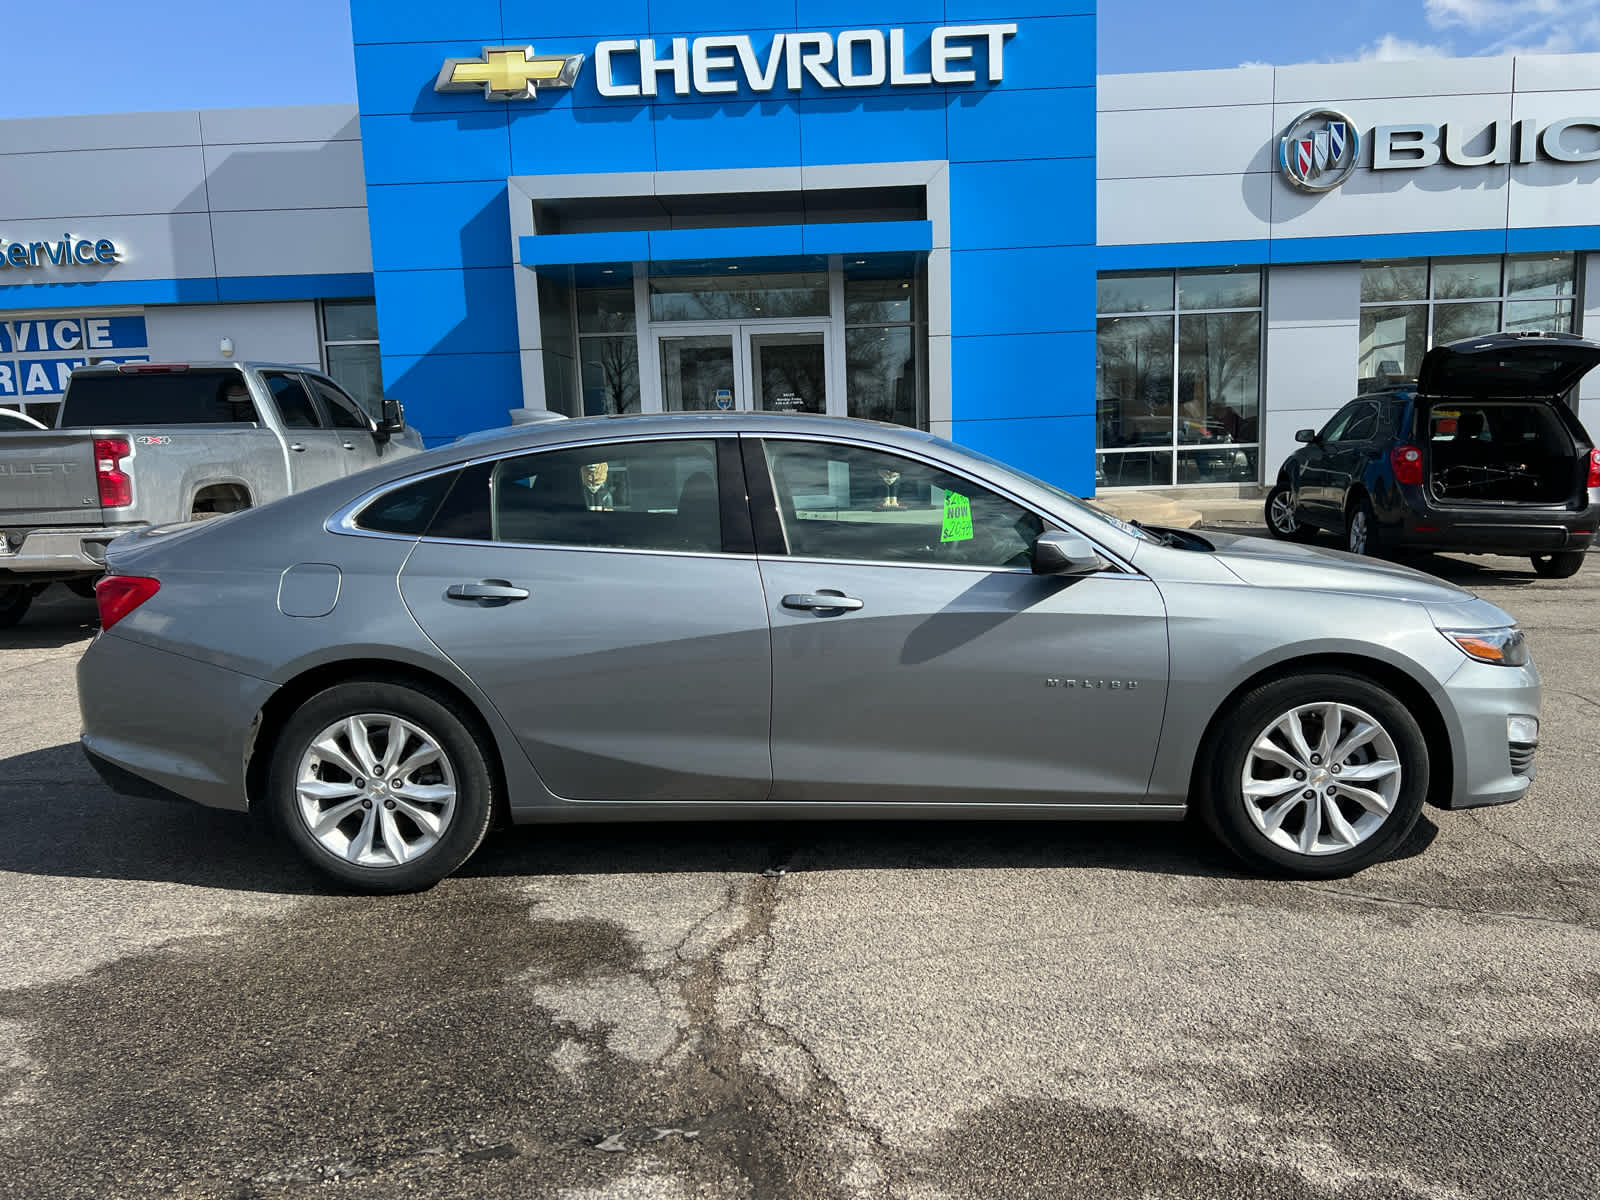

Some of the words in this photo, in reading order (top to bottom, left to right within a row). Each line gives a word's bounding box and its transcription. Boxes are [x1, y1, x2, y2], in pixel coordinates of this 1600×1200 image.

[594, 23, 1017, 98] CHEVROLET
[947, 505, 968, 519] NOW
[1045, 678, 1139, 689] MALIBU
